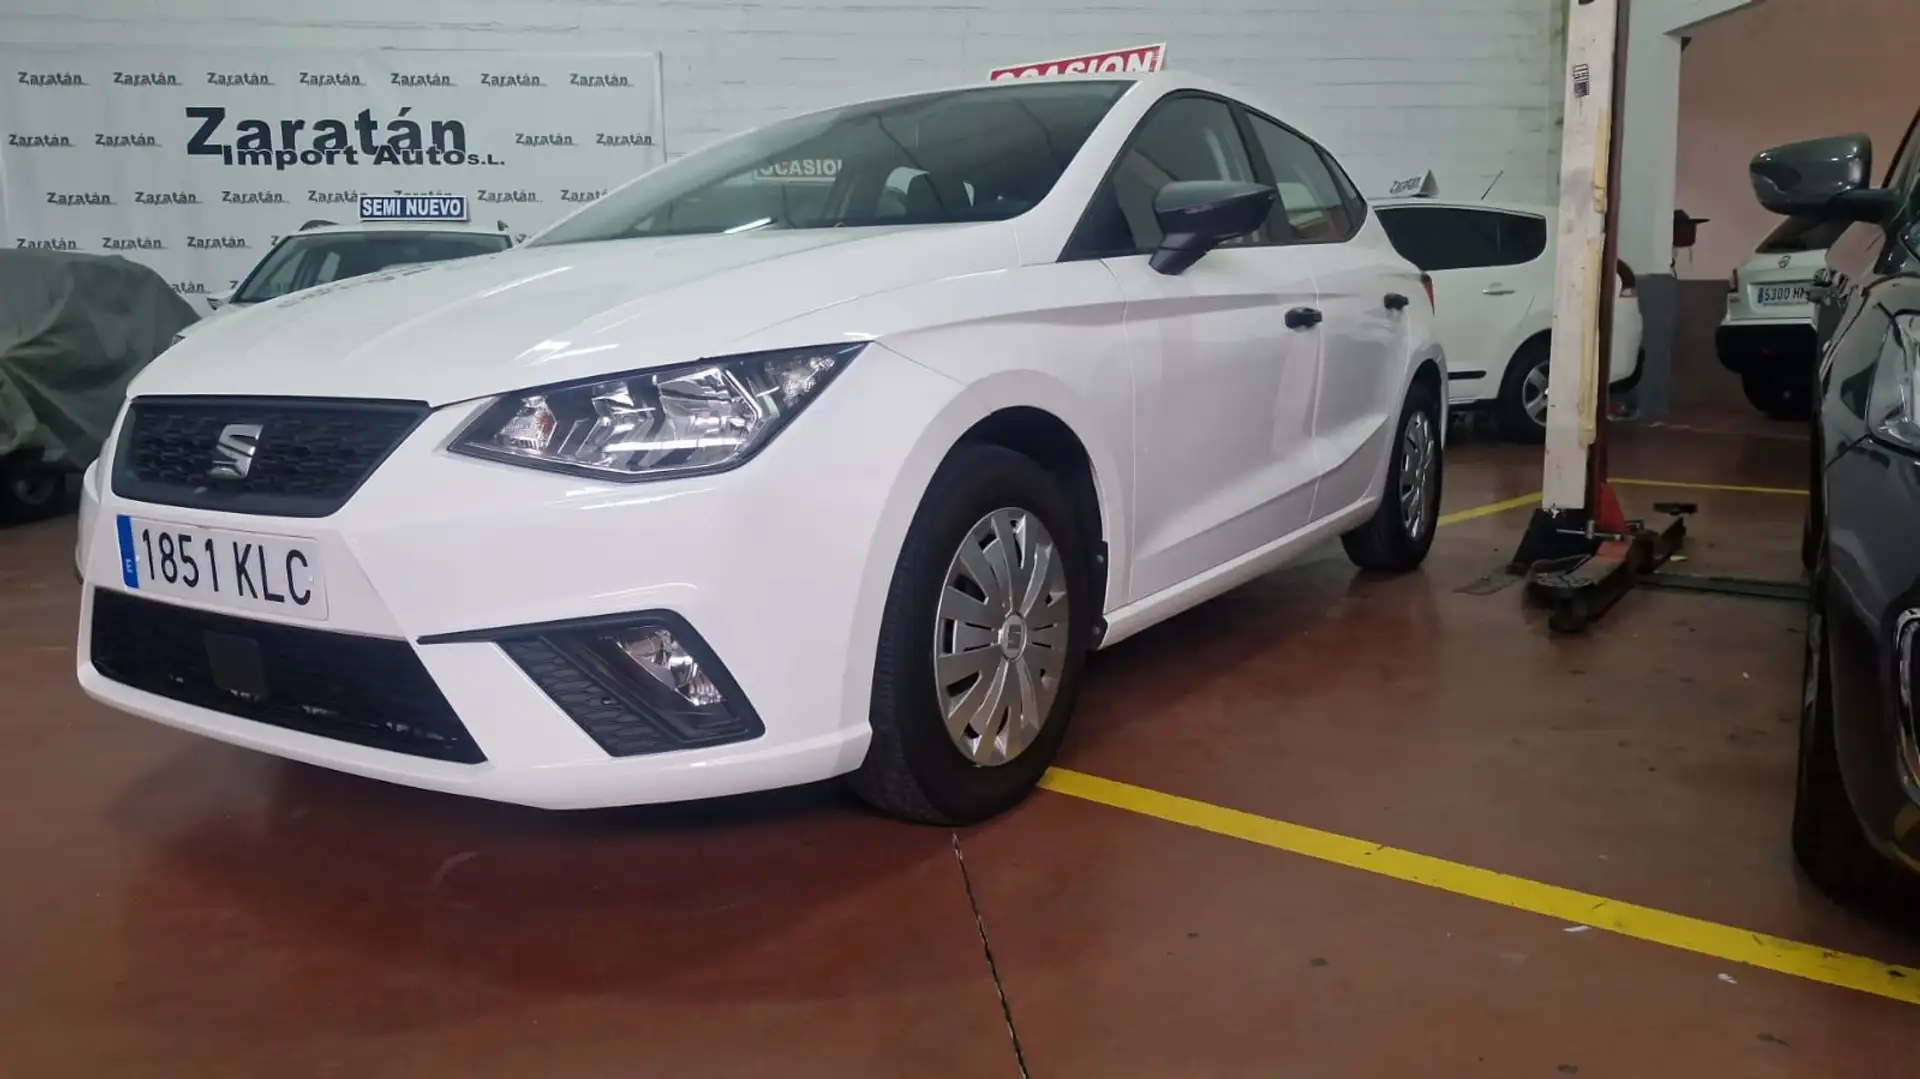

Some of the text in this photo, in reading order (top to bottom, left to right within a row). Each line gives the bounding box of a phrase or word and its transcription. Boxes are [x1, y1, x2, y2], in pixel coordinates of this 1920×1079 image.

[186, 106, 466, 155] Zaratán
[223, 144, 358, 170] Import
[362, 198, 461, 217] SEMI NUEVO
[142, 529, 311, 605] 1851 KLC
